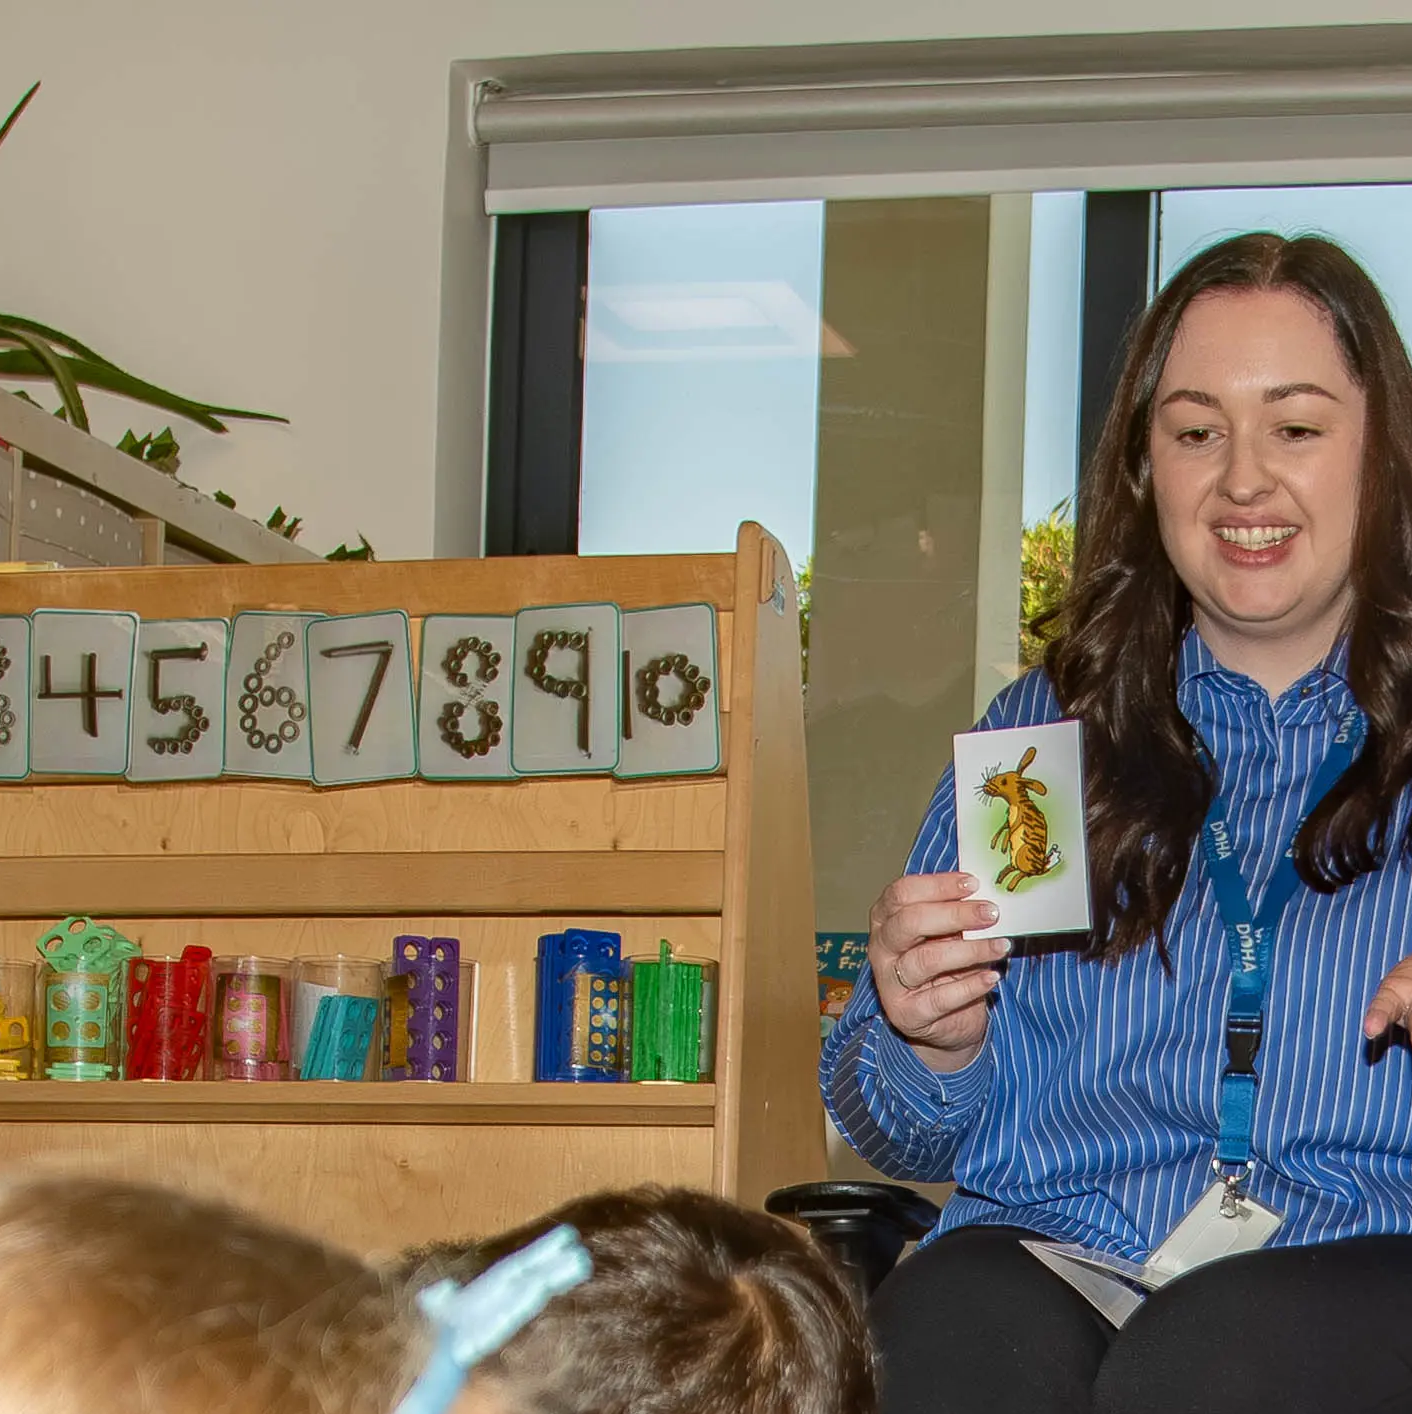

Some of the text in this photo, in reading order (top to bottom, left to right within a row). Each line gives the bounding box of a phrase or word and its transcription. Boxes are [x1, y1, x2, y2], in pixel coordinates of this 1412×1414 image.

[37, 651, 124, 737] 4
[149, 641, 210, 755] 5
[239, 630, 306, 754] 6
[320, 640, 394, 755] 7
[438, 636, 503, 759] 8
[527, 626, 593, 759] 9
[622, 650, 712, 741] 10
[1236, 923, 1258, 973] DOHA
